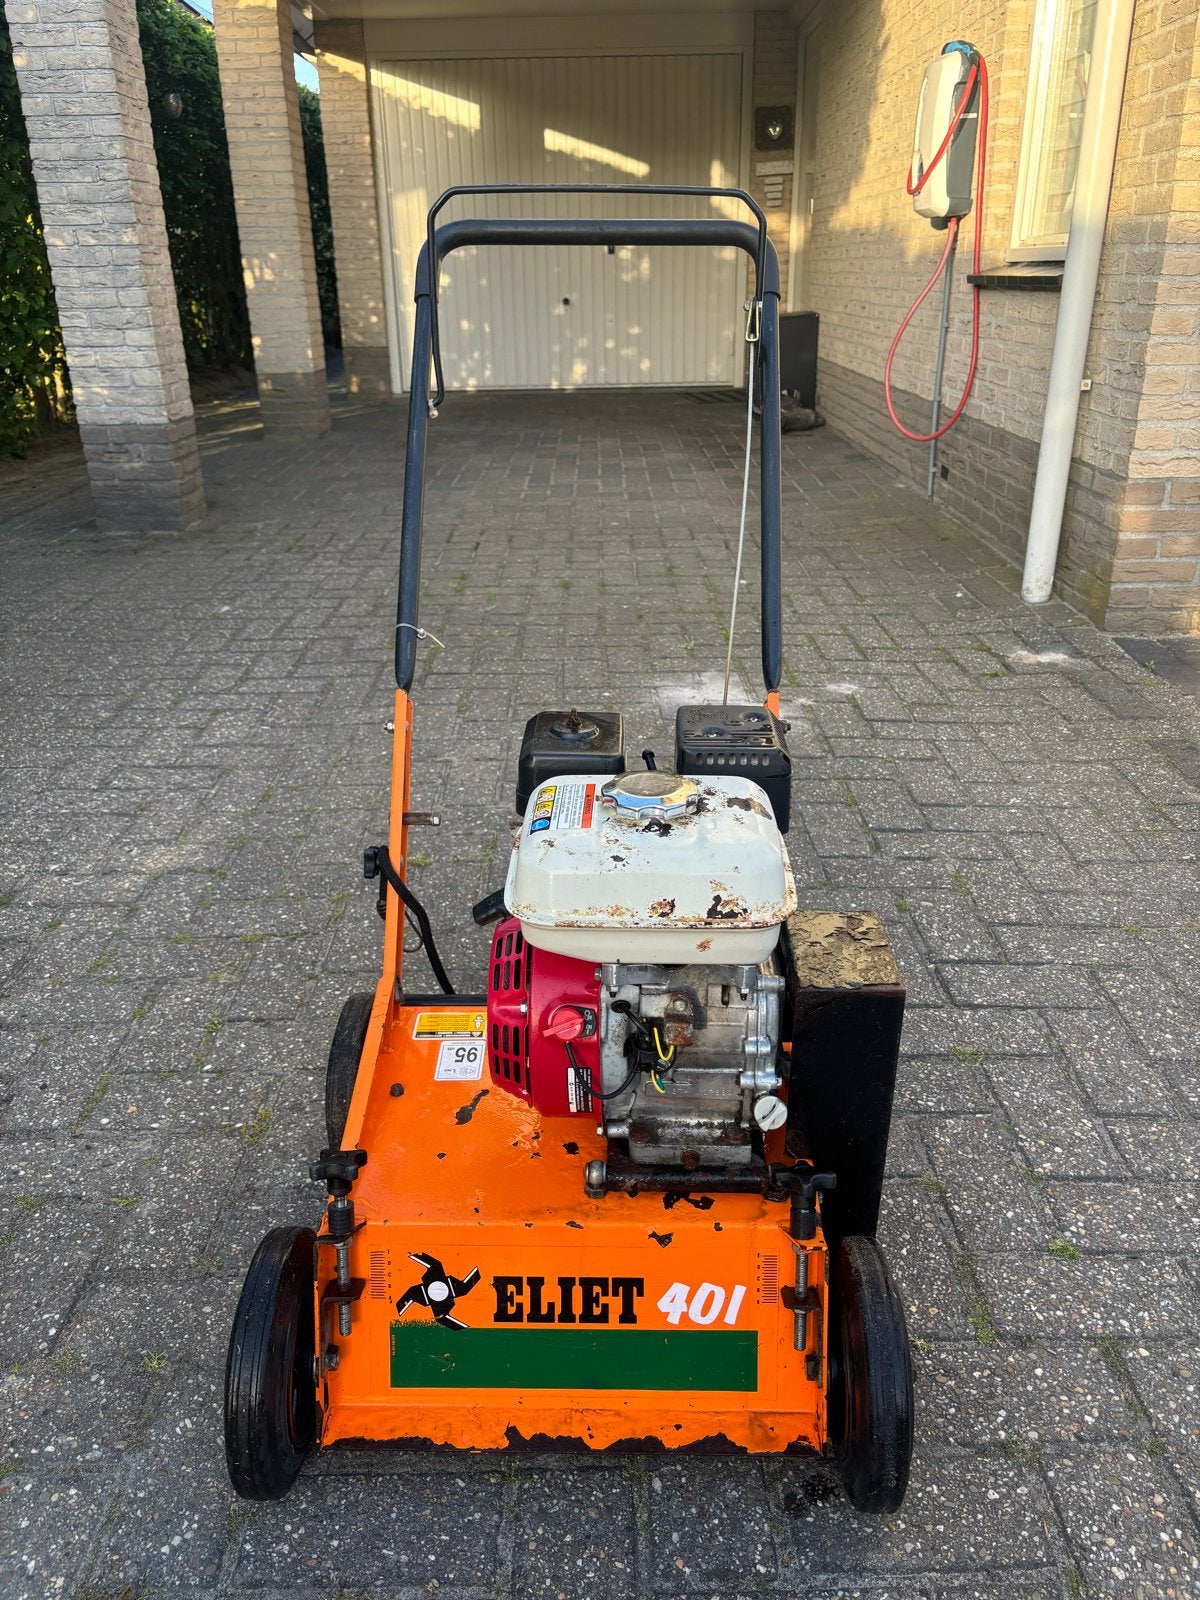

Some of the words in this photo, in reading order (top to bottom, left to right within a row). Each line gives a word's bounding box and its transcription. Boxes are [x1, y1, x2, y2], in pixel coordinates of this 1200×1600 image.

[455, 1047, 478, 1063] 95
[493, 1276, 644, 1324] ELIET
[656, 1282, 747, 1325] 401
